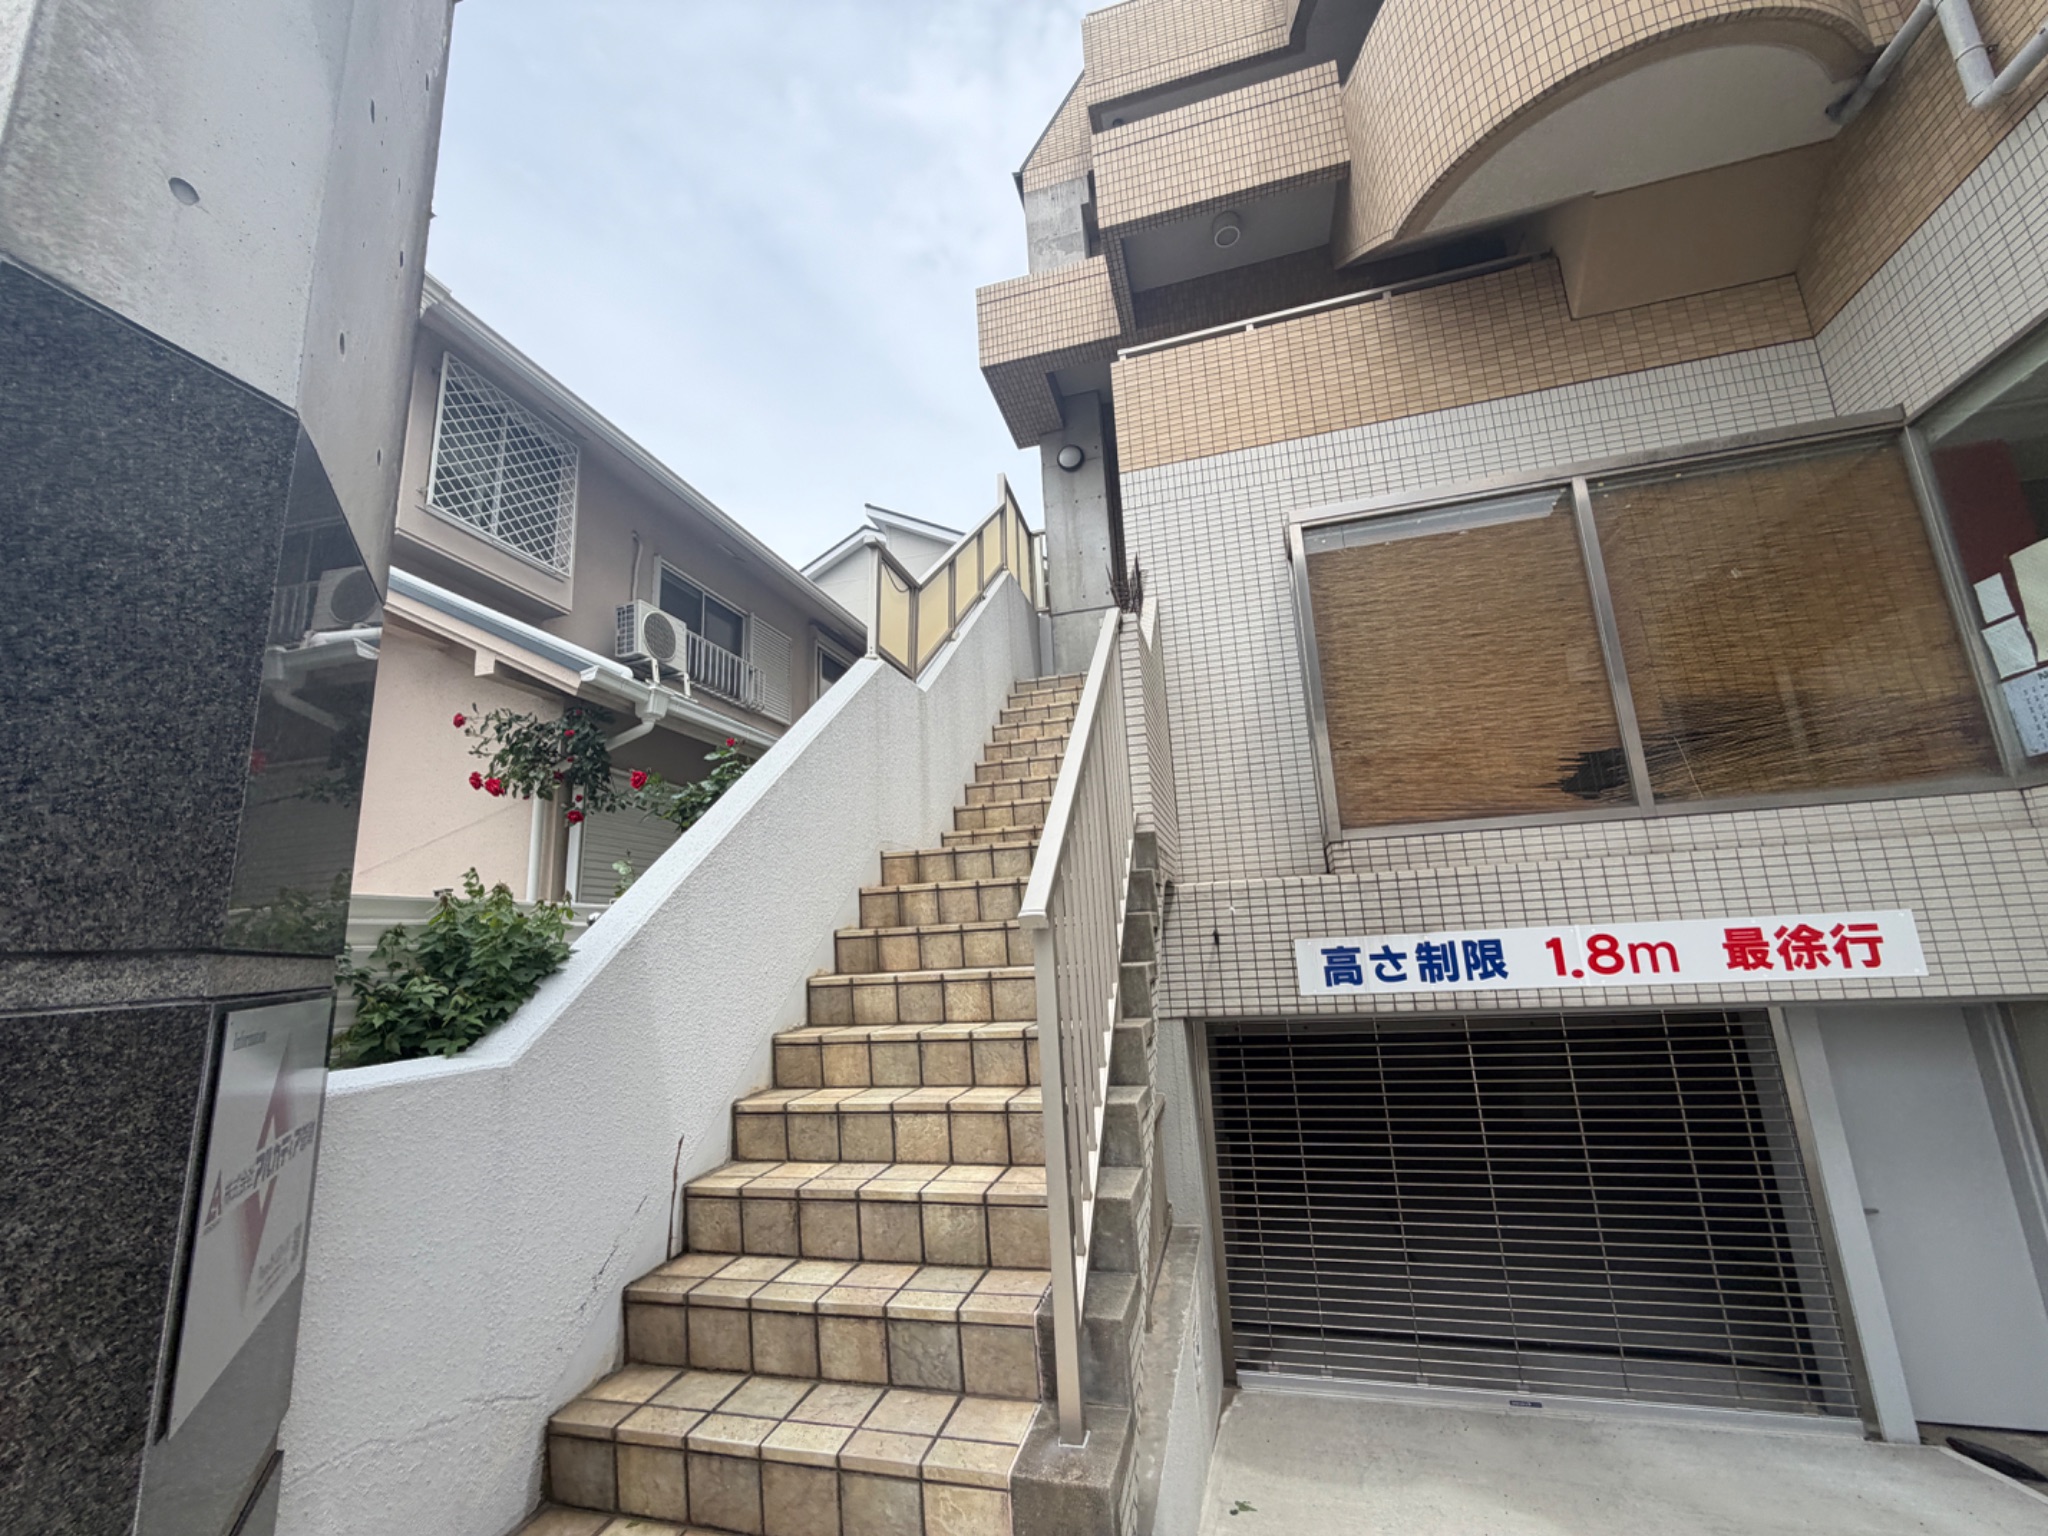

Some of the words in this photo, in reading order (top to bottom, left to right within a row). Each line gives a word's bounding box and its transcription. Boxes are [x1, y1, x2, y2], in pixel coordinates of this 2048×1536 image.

[1320, 938, 1509, 987] 高さ制限
[1545, 933, 1680, 979] 1.8m
[1722, 923, 1884, 971] 最徐行
